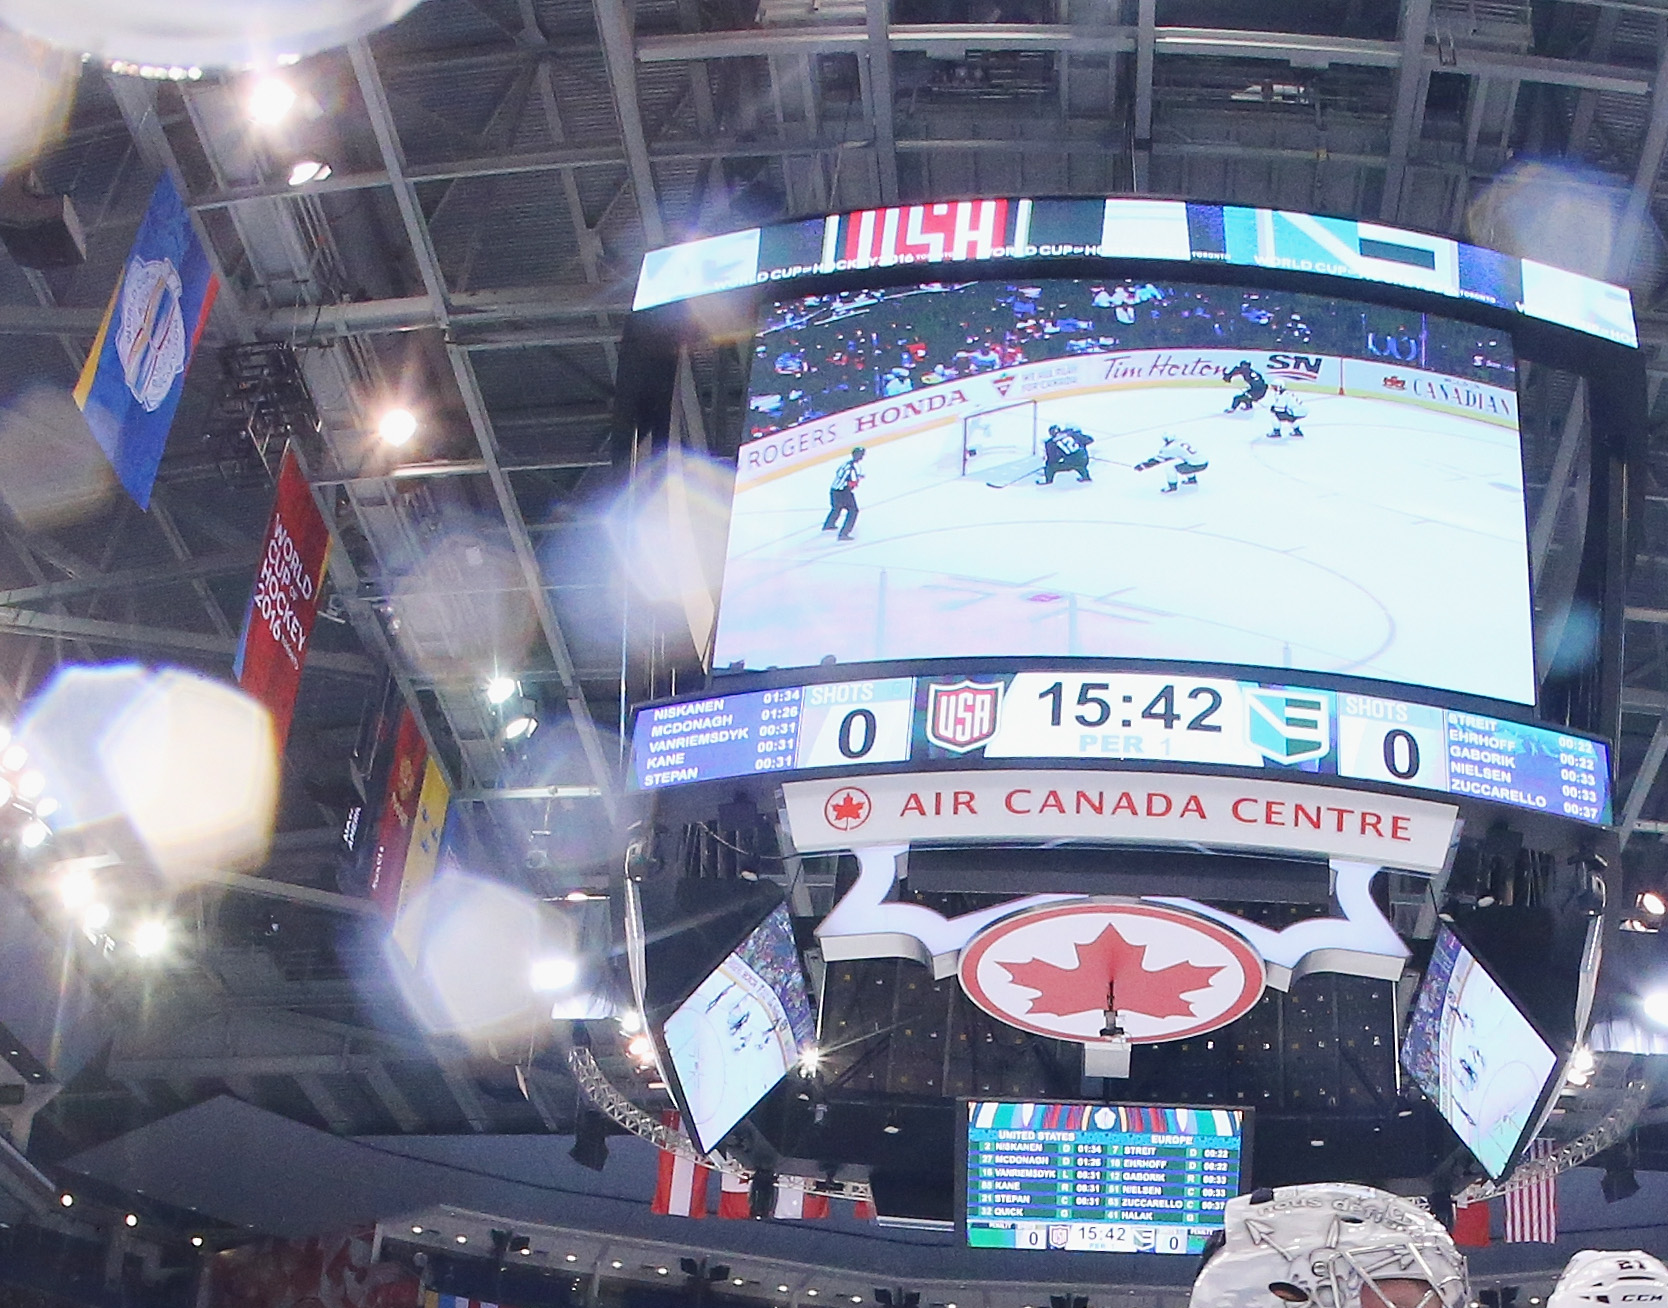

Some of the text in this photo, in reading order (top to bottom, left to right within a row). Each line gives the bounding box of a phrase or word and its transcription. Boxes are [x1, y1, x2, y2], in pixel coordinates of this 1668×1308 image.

[1253, 254, 1313, 273] WORLD
[1103, 355, 1142, 381] Tim
[1148, 353, 1230, 377] Horton
[1413, 376, 1512, 416] CANADIAN
[748, 389, 969, 467] ROGERS HONDA
[268, 538, 292, 586] CUP
[274, 512, 313, 600] WORLD
[253, 582, 283, 642] 2016
[260, 557, 307, 652] HOCKEY
[653, 689, 800, 721] NISKANEN 01:34
[810, 682, 874, 706] SHOTS
[1037, 681, 1223, 733] 15:42
[1345, 696, 1408, 723] SHOTS
[651, 705, 798, 738] MCDONAGH 01:26
[938, 685, 991, 741] USA
[648, 721, 796, 753] VANRIEMSDYK 00:31
[837, 707, 878, 760] 0
[1078, 734, 1145, 755] PER
[1447, 712, 1595, 755] STREIT 00:22
[646, 739, 794, 770] KANE 00:31
[1382, 728, 1421, 781] 0
[1448, 729, 1595, 771] EHRHOFF 00:22
[1449, 745, 1596, 787] GABORIK 00:33
[644, 755, 792, 787] STEPAN 00:31
[1450, 761, 1597, 803] NIELSEN 00:33
[1451, 777, 1598, 820] ZUCCARELLO 00:37
[899, 788, 1412, 842] AIR CANADA CENTRE
[995, 1141, 1044, 1152] NISKANEN
[1123, 1146, 1157, 1156] STREIT
[998, 1130, 1195, 1146] UNITED STATES EUROPE
[994, 1181, 1021, 1191] KANE
[1122, 1185, 1162, 1195] NIELSEN
[994, 1194, 1032, 1204] STEPAN
[1121, 1198, 1184, 1209] ZUCCARELLO
[994, 1207, 1024, 1217] QUICK
[1121, 1211, 1153, 1220] HALAK
[1028, 1231, 1039, 1246] 0
[1078, 1226, 1126, 1242] 15:42
[1168, 1236, 1179, 1251] 0
[1621, 1293, 1663, 1302] CCM
